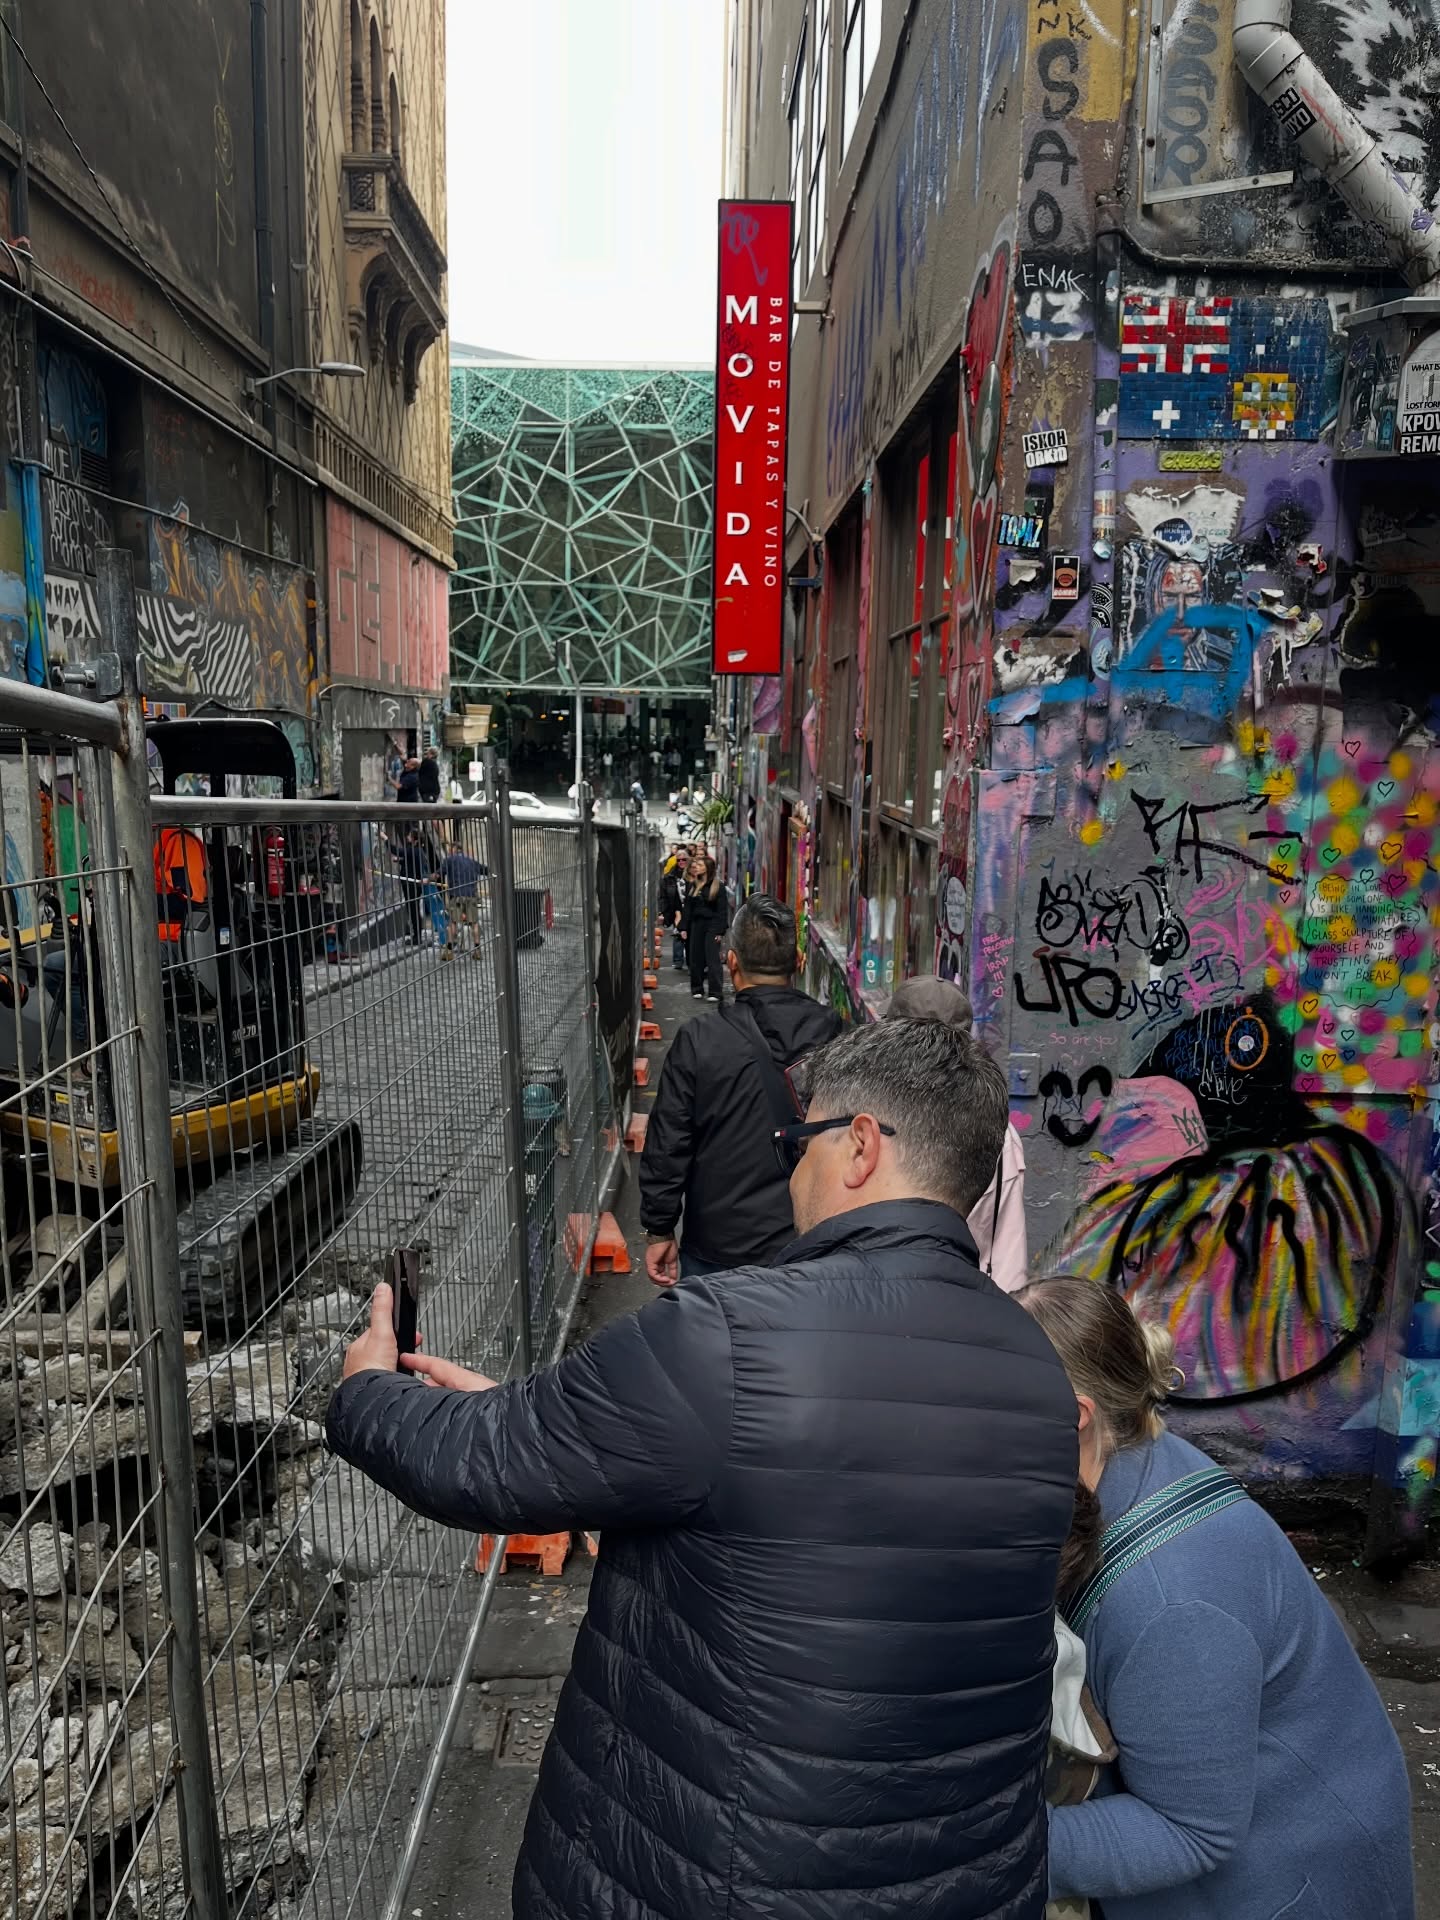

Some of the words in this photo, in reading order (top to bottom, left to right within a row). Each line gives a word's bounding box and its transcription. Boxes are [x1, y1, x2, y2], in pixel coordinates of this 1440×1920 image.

[1022, 263, 1090, 301] ENAK
[768, 297, 783, 343] BAR
[768, 361, 781, 389] DE
[1411, 363, 1433, 371] WHAT
[1406, 401, 1424, 410] LOST
[723, 295, 758, 586] MOVIDA
[766, 406, 780, 481] TAPAS
[1400, 435, 1440, 454] REM
[765, 499, 778, 508] Y
[999, 514, 1043, 548] TOPAZ
[764, 526, 778, 587] VINO
[1322, 883, 1346, 893] BEING
[1318, 895, 1341, 903] WITH
[1346, 894, 1385, 903] SOMEONE
[1317, 905, 1326, 913] IS
[1331, 905, 1349, 913] LIKE
[1356, 904, 1393, 913] HANDING
[1315, 915, 1344, 925] THEM
[1362, 912, 1413, 926] MINIATURE
[1311, 930, 1338, 940] GLASS
[1341, 926, 1392, 941] SCULPTURE
[1394, 929, 1409, 940] OF
[1314, 942, 1360, 953] YOURSELF
[1364, 939, 1385, 950] AND
[1314, 956, 1370, 968] TRUSTING
[1377, 952, 1402, 965] THEY
[1355, 965, 1393, 982] BREAK
